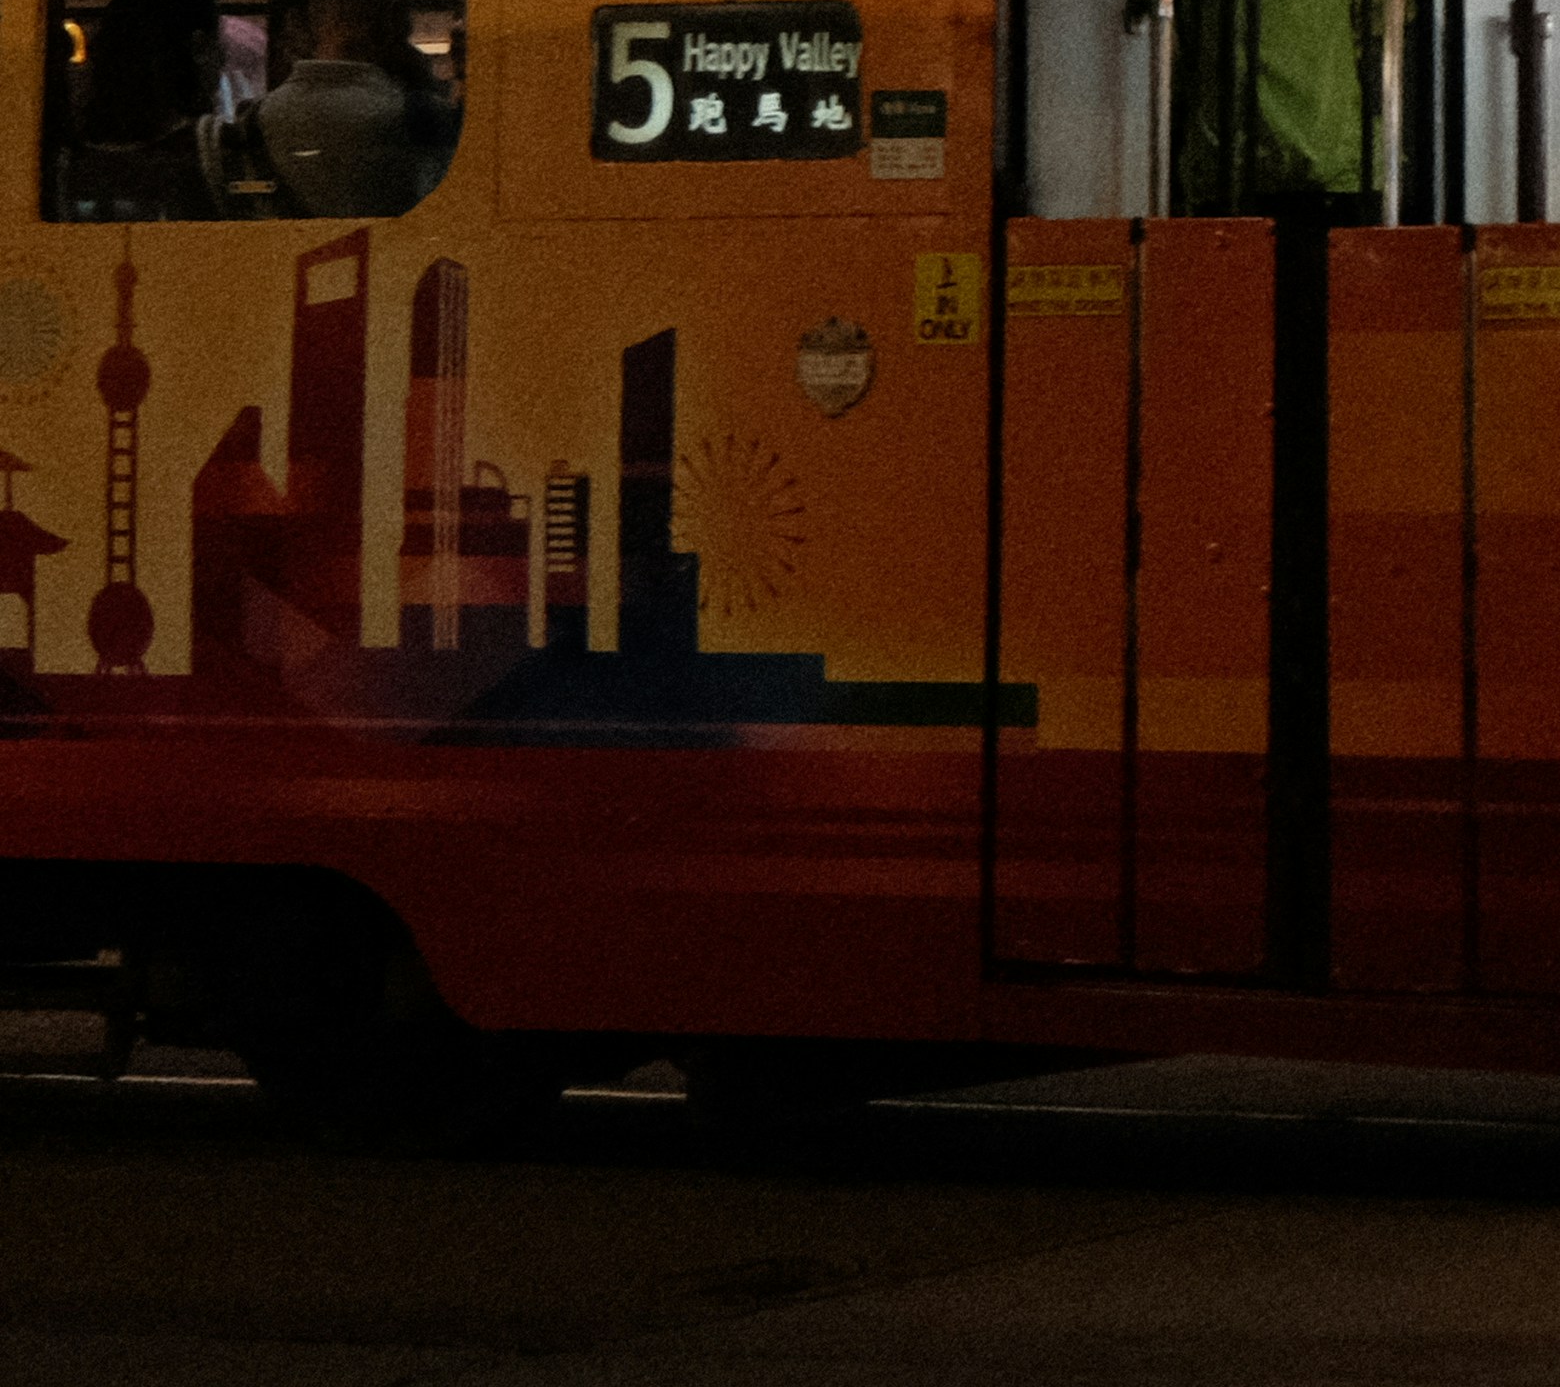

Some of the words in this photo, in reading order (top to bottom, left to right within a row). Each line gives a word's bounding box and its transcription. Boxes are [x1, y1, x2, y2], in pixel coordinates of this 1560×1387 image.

[607, 20, 675, 145] 5
[683, 32, 770, 81] Happy
[778, 30, 863, 80] Valley
[688, 91, 854, 135] 跑馬地
